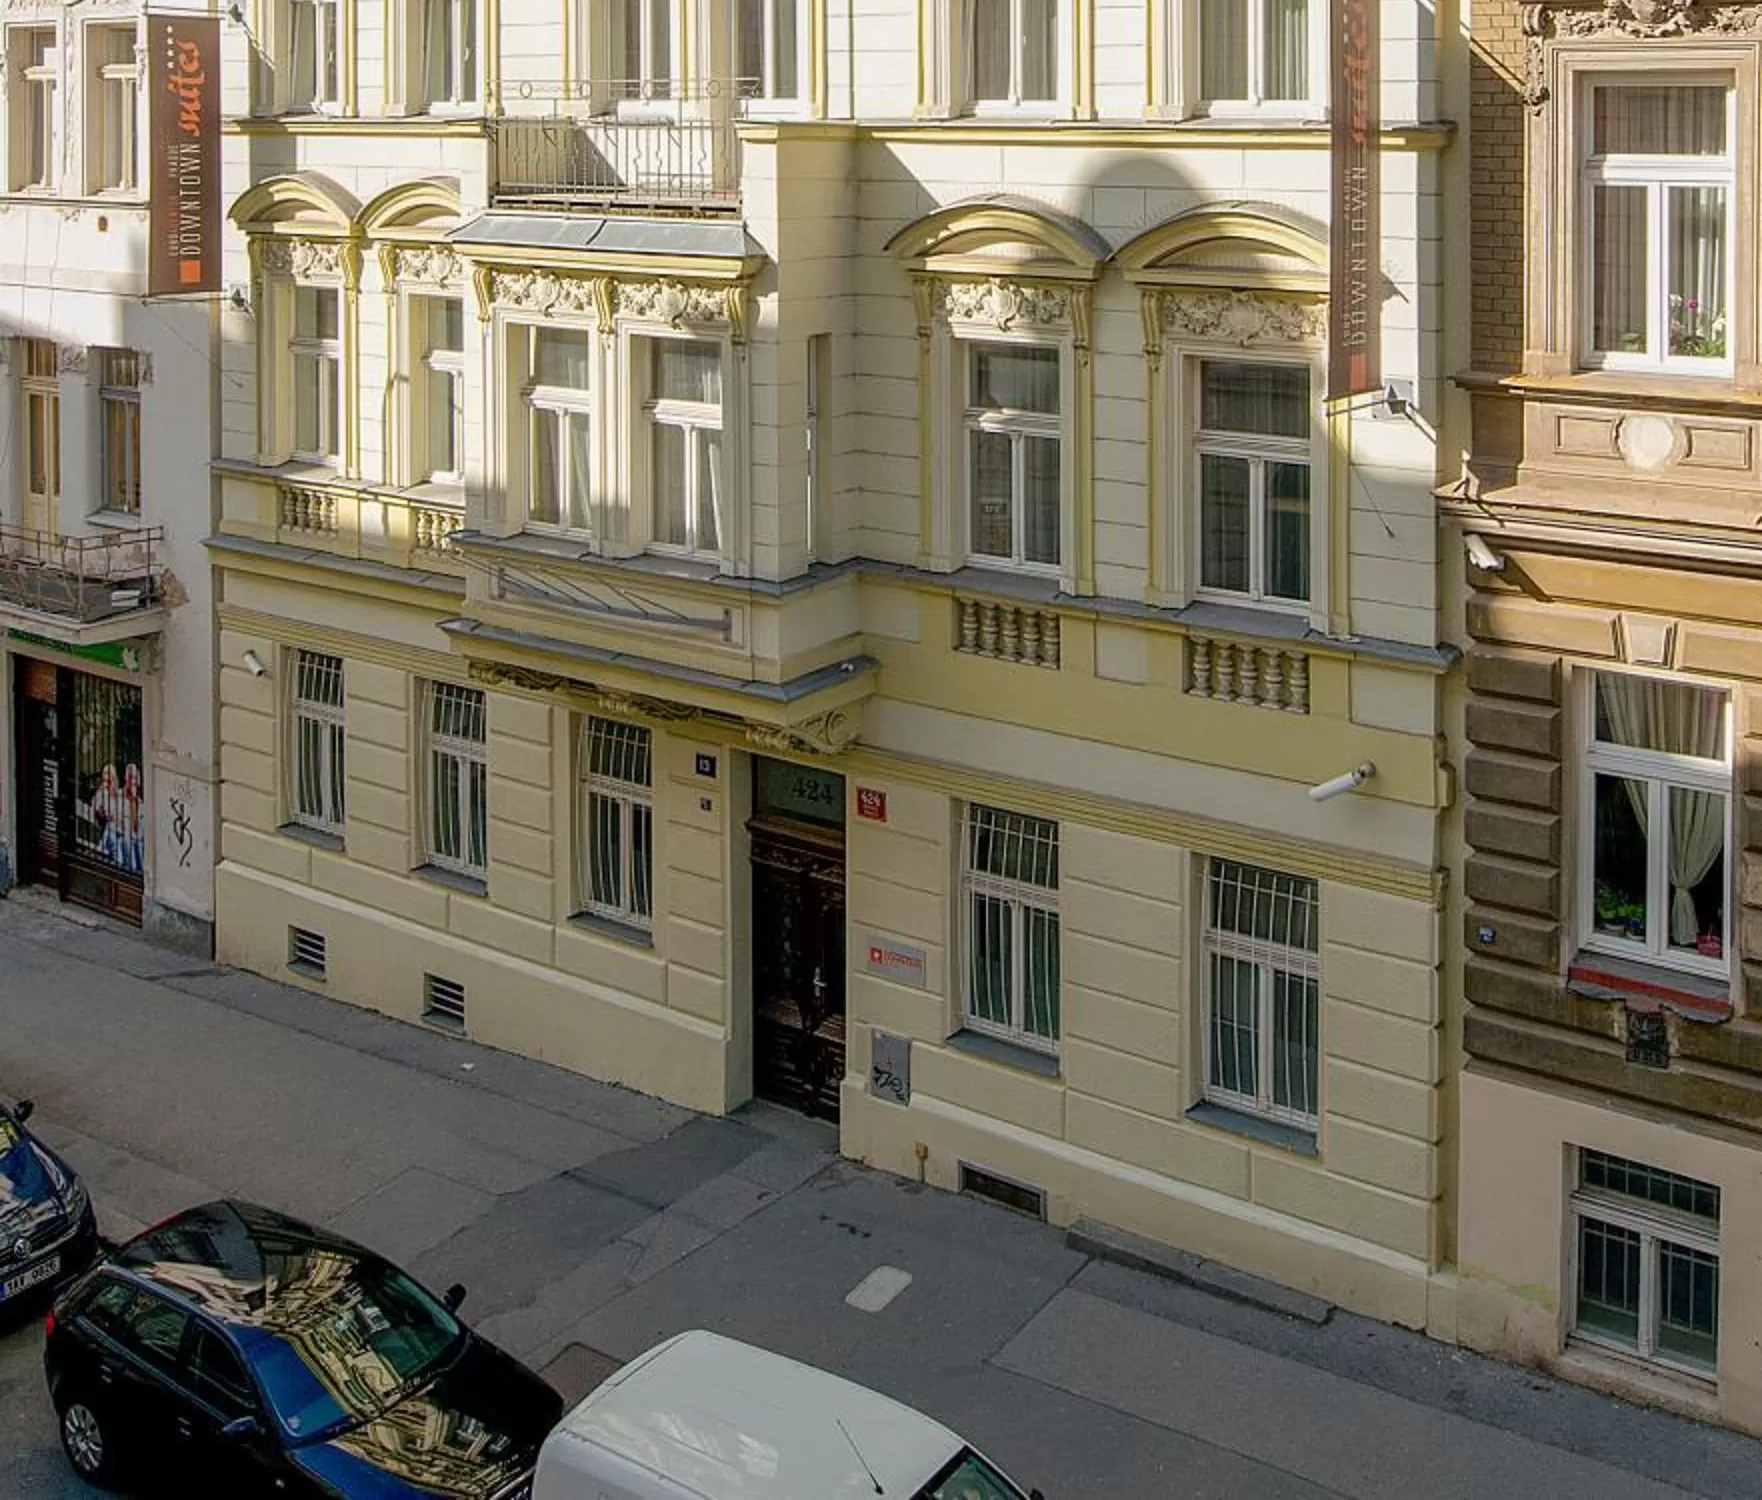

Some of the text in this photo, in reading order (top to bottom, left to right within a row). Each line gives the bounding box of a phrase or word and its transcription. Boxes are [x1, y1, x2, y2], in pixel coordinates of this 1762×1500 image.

[167, 39, 205, 257] DOWNTOWN suites
[1351, 165, 1369, 346] DOWNTOWN
[794, 776, 833, 804] 424
[861, 791, 881, 808] 424
